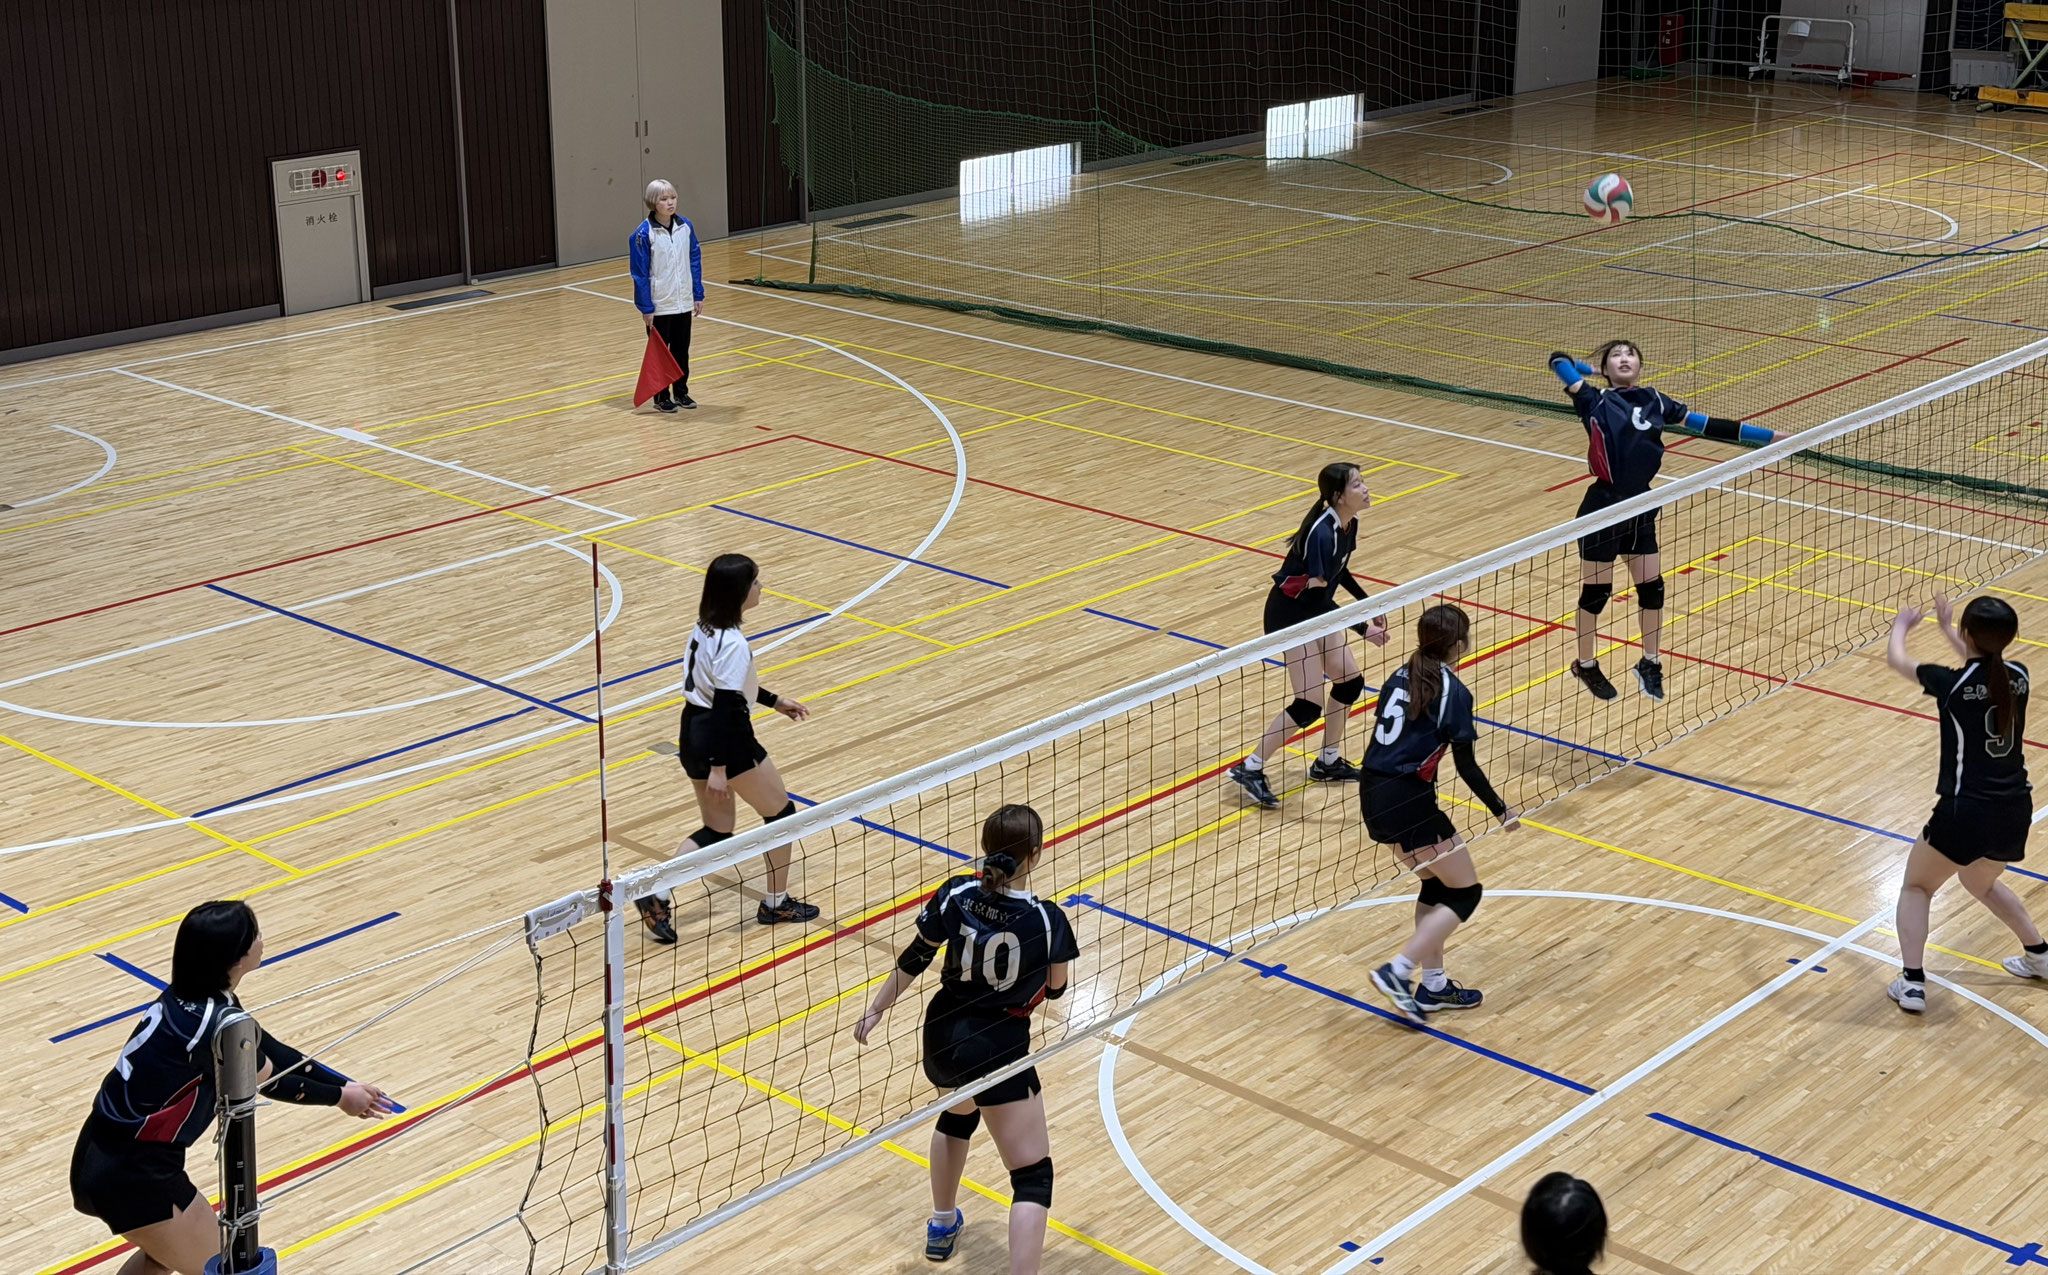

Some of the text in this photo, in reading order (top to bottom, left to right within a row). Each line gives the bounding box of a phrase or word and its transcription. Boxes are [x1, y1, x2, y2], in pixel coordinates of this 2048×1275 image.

[305, 212, 338, 226] 消火栓
[1375, 687, 1411, 746] 5
[1985, 704, 2015, 758] 9
[959, 922, 1021, 992] 10
[115, 1002, 163, 1082] 2
